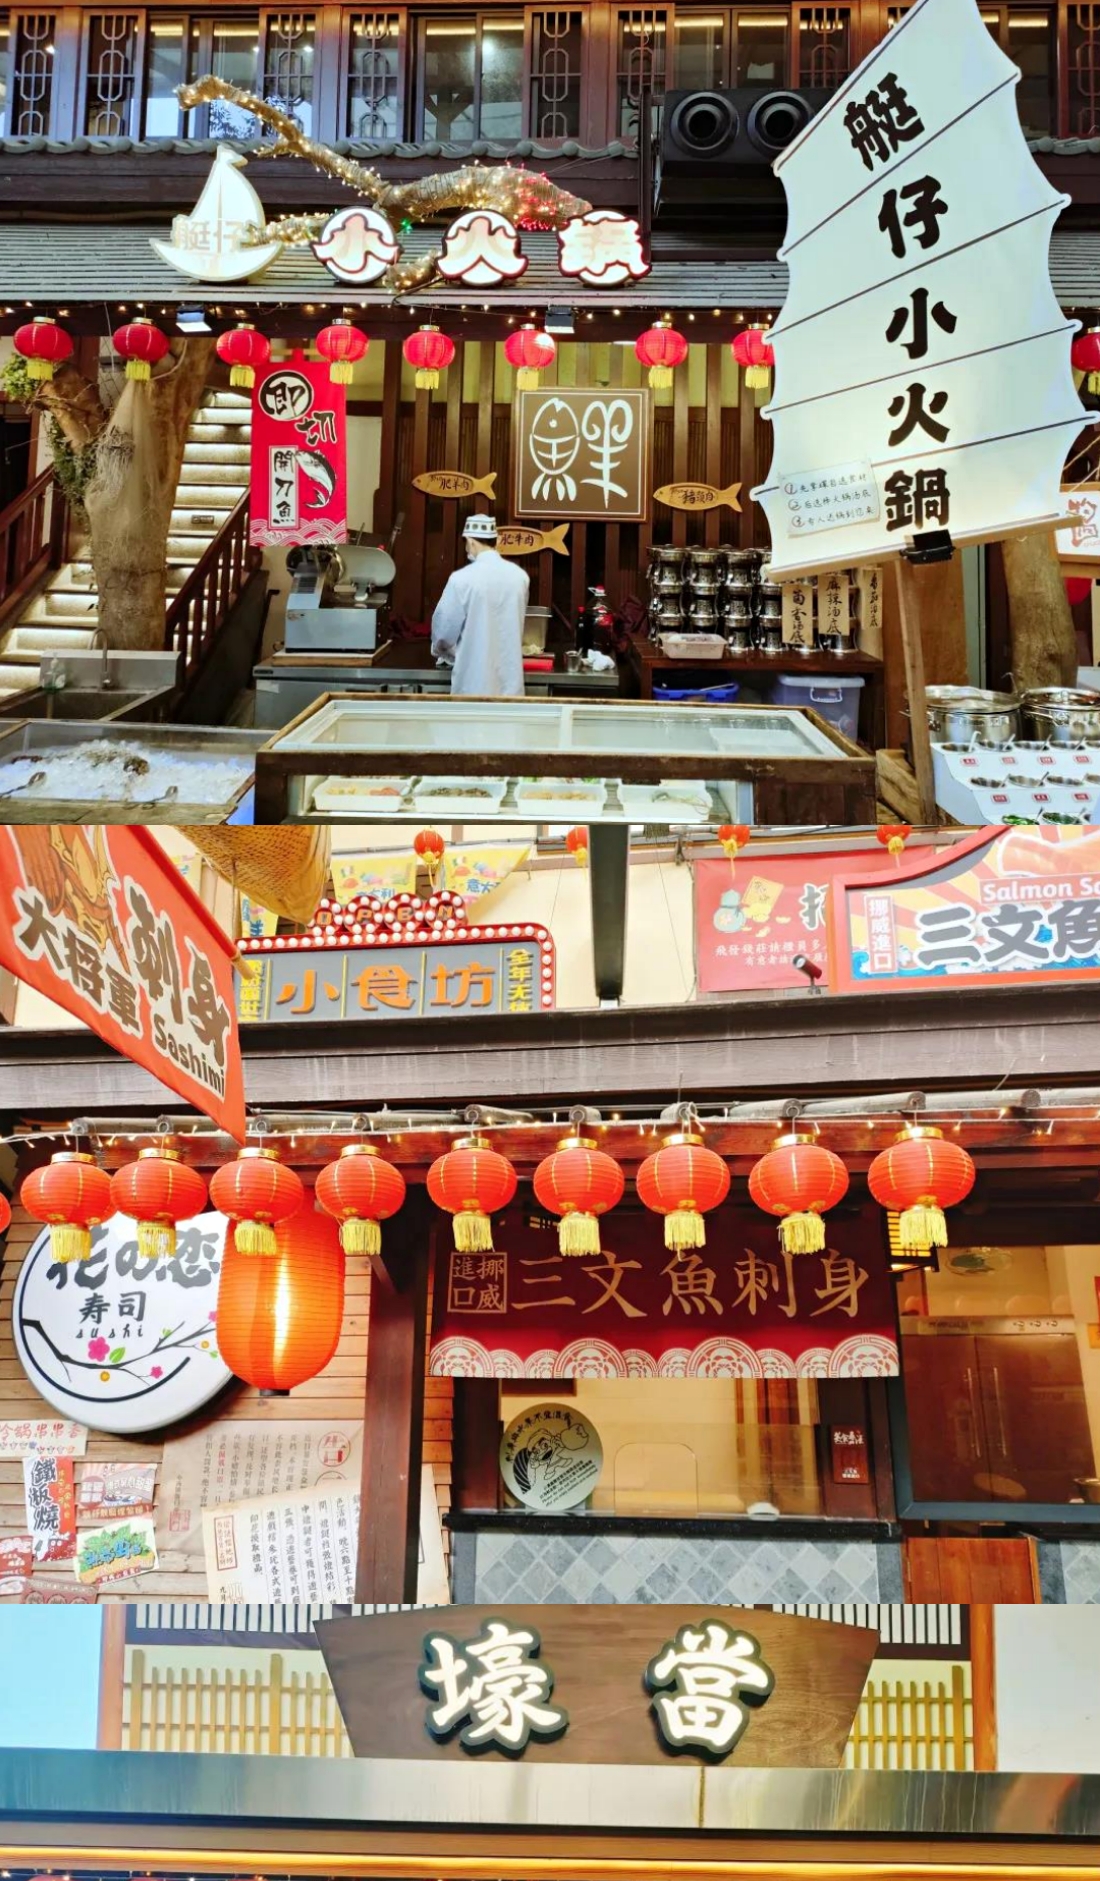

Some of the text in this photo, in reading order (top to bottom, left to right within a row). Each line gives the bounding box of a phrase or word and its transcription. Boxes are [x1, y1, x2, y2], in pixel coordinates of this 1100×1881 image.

[843, 72, 957, 532] 艇仔小火鍋
[264, 378, 337, 446] 即切
[316, 903, 454, 927] OPEN
[983, 880, 1073, 902] Salmon
[868, 899, 894, 970] 挪威進口
[129, 885, 230, 1067] 刺身
[275, 961, 496, 1015] 小食坊
[153, 1012, 226, 1098] Sashimi
[79, 1290, 147, 1325] 寿司
[511, 1248, 870, 1319] 三文魚刺身
[74, 1322, 145, 1340] sushi
